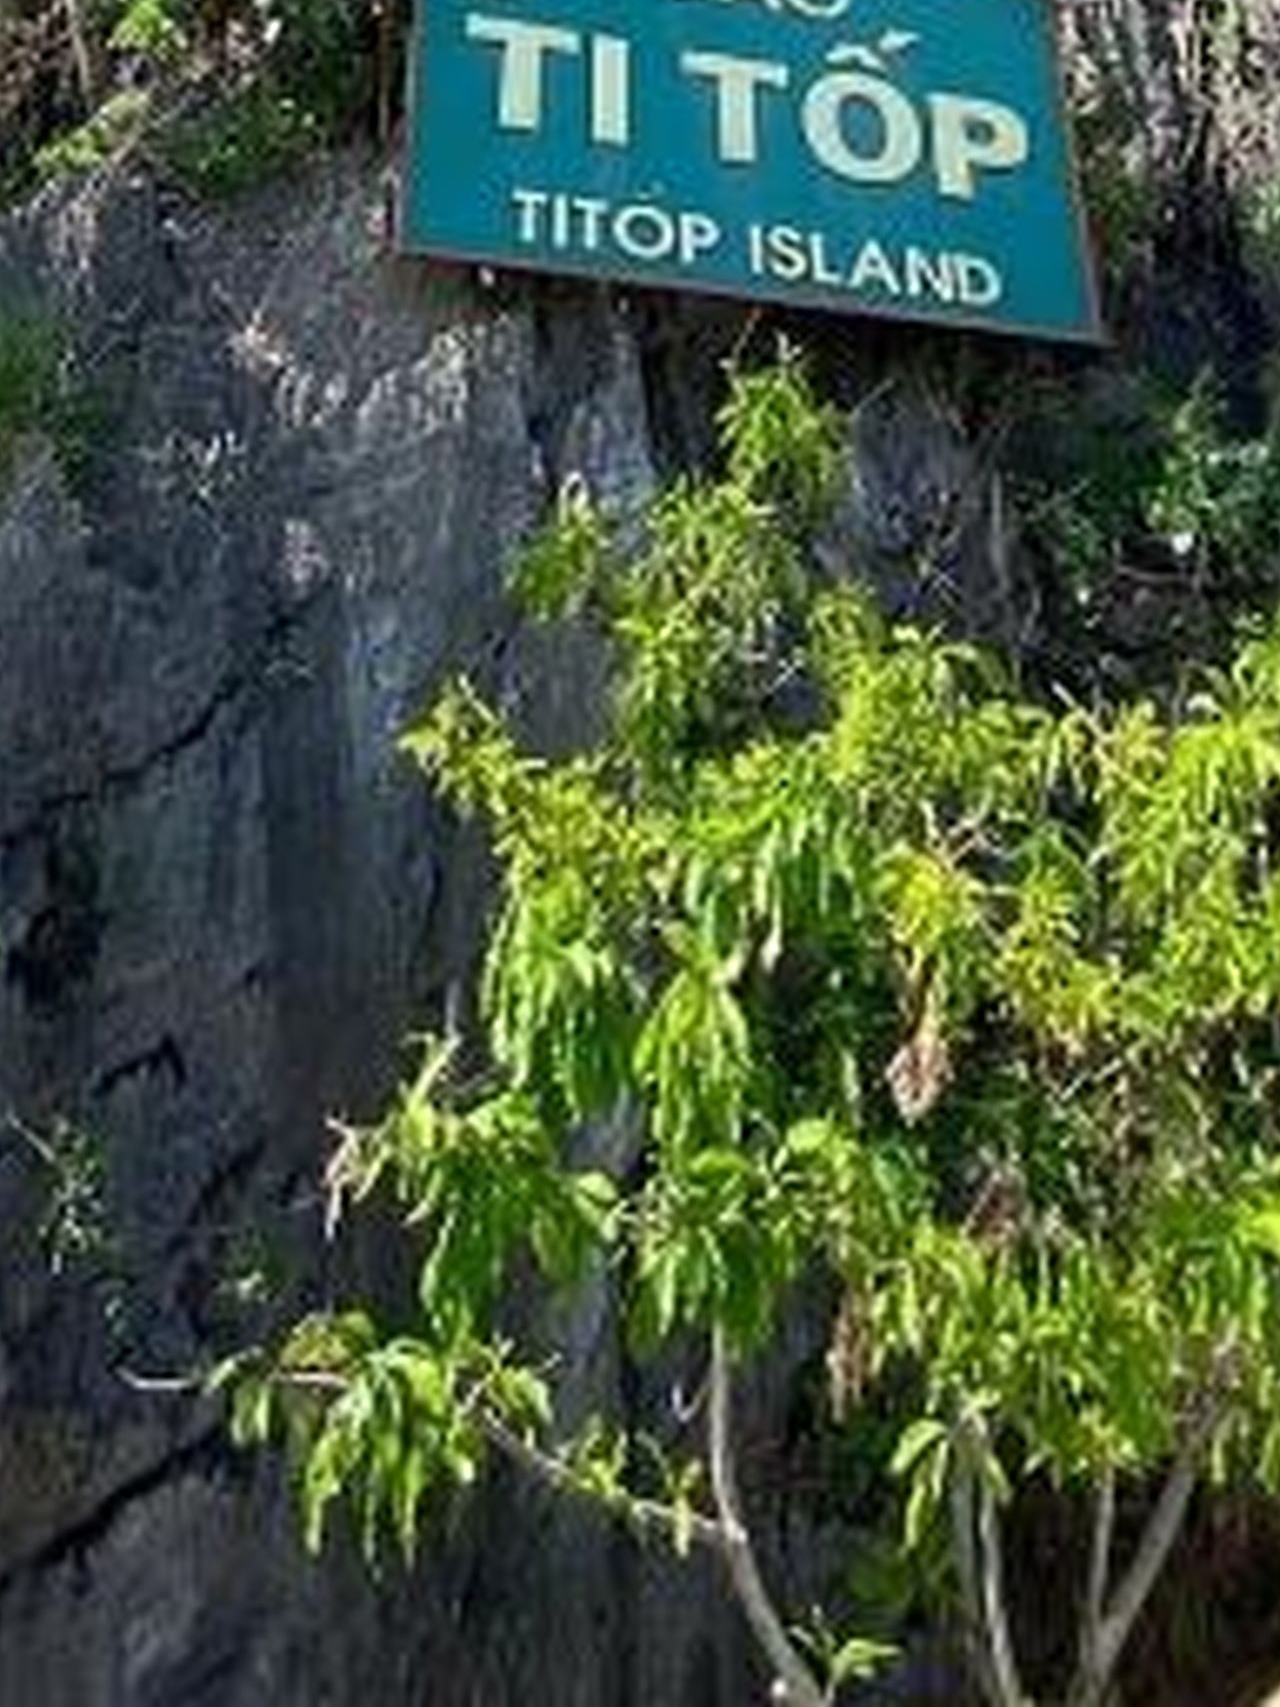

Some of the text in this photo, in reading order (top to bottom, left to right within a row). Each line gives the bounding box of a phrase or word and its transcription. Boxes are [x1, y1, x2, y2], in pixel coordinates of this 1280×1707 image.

[465, 13, 1028, 201] TI TỐP
[749, 226, 1001, 305] ISLAND
